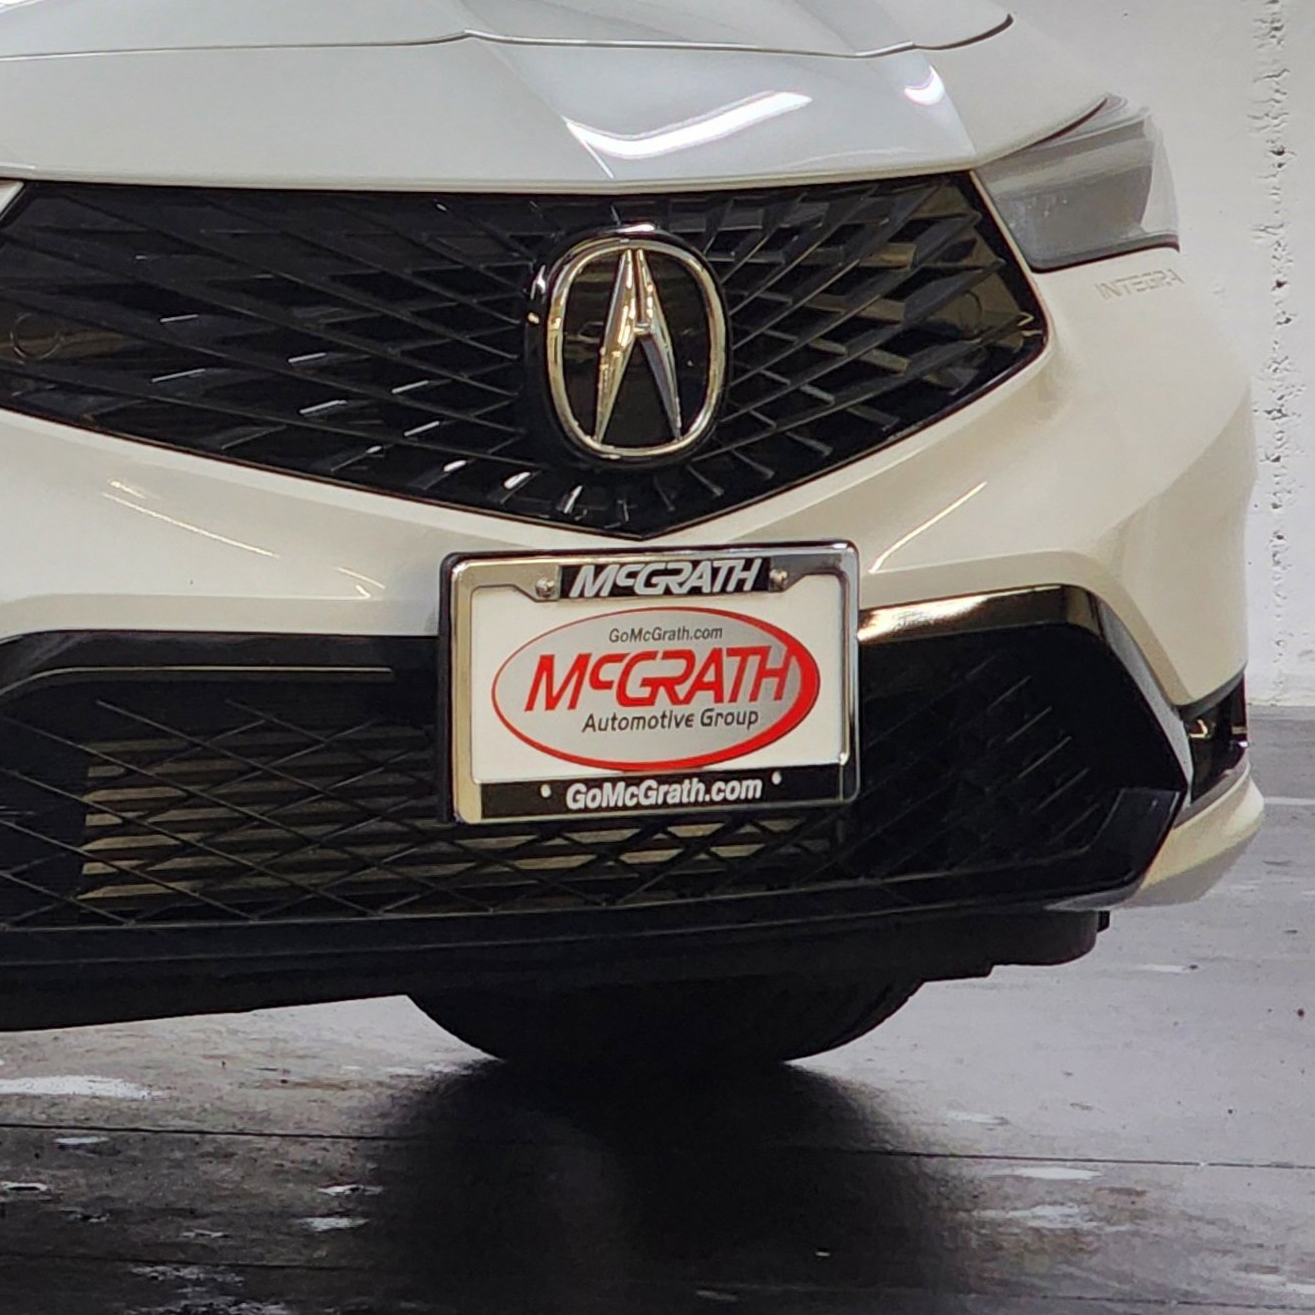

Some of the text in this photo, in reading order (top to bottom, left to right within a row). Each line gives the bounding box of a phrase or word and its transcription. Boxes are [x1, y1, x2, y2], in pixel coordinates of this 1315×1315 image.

[608, 626, 723, 644] GoMcGrath.com
[581, 708, 760, 733] Automotive Group
[565, 776, 763, 811] GoMcGrath.com
